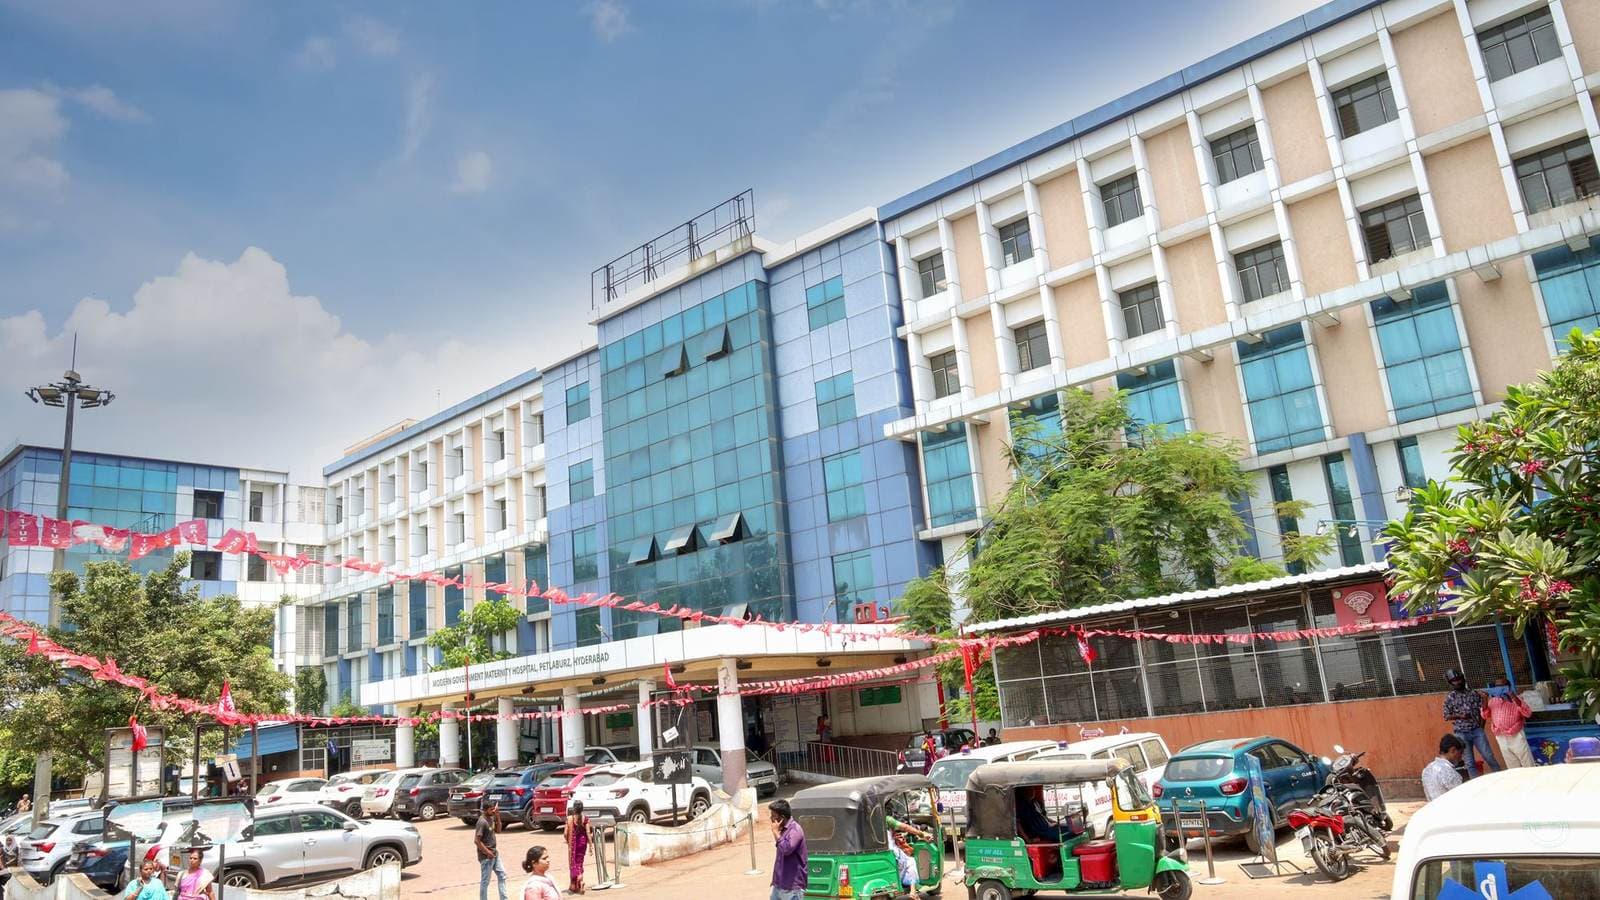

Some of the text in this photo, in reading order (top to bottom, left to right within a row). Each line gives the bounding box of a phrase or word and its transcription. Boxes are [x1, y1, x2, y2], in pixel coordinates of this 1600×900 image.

[432, 677, 452, 687] MODERN
[484, 668, 512, 680] MATERNITY
[573, 652, 610, 667] HYDERABAD
